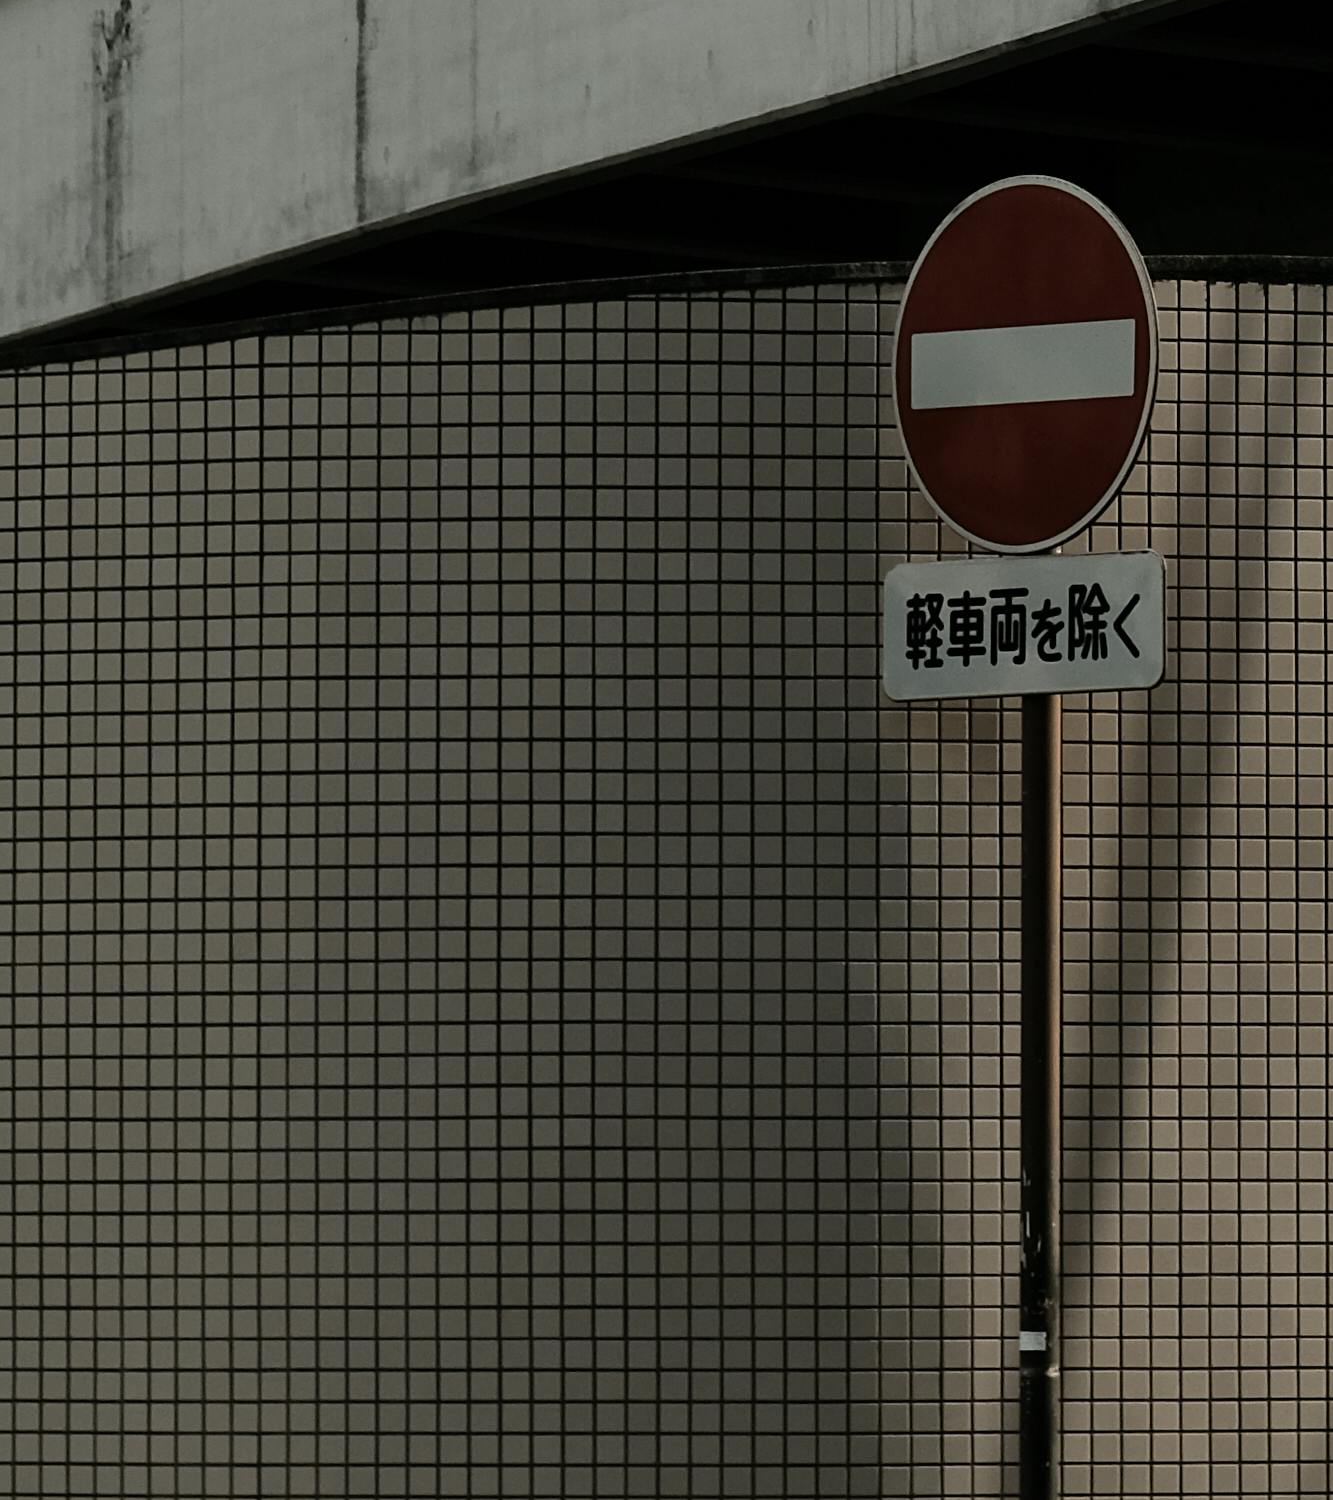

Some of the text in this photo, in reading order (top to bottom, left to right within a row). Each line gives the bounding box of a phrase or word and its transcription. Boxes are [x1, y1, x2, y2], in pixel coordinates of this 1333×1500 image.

[905, 582, 1141, 670] 軽車両を除く
